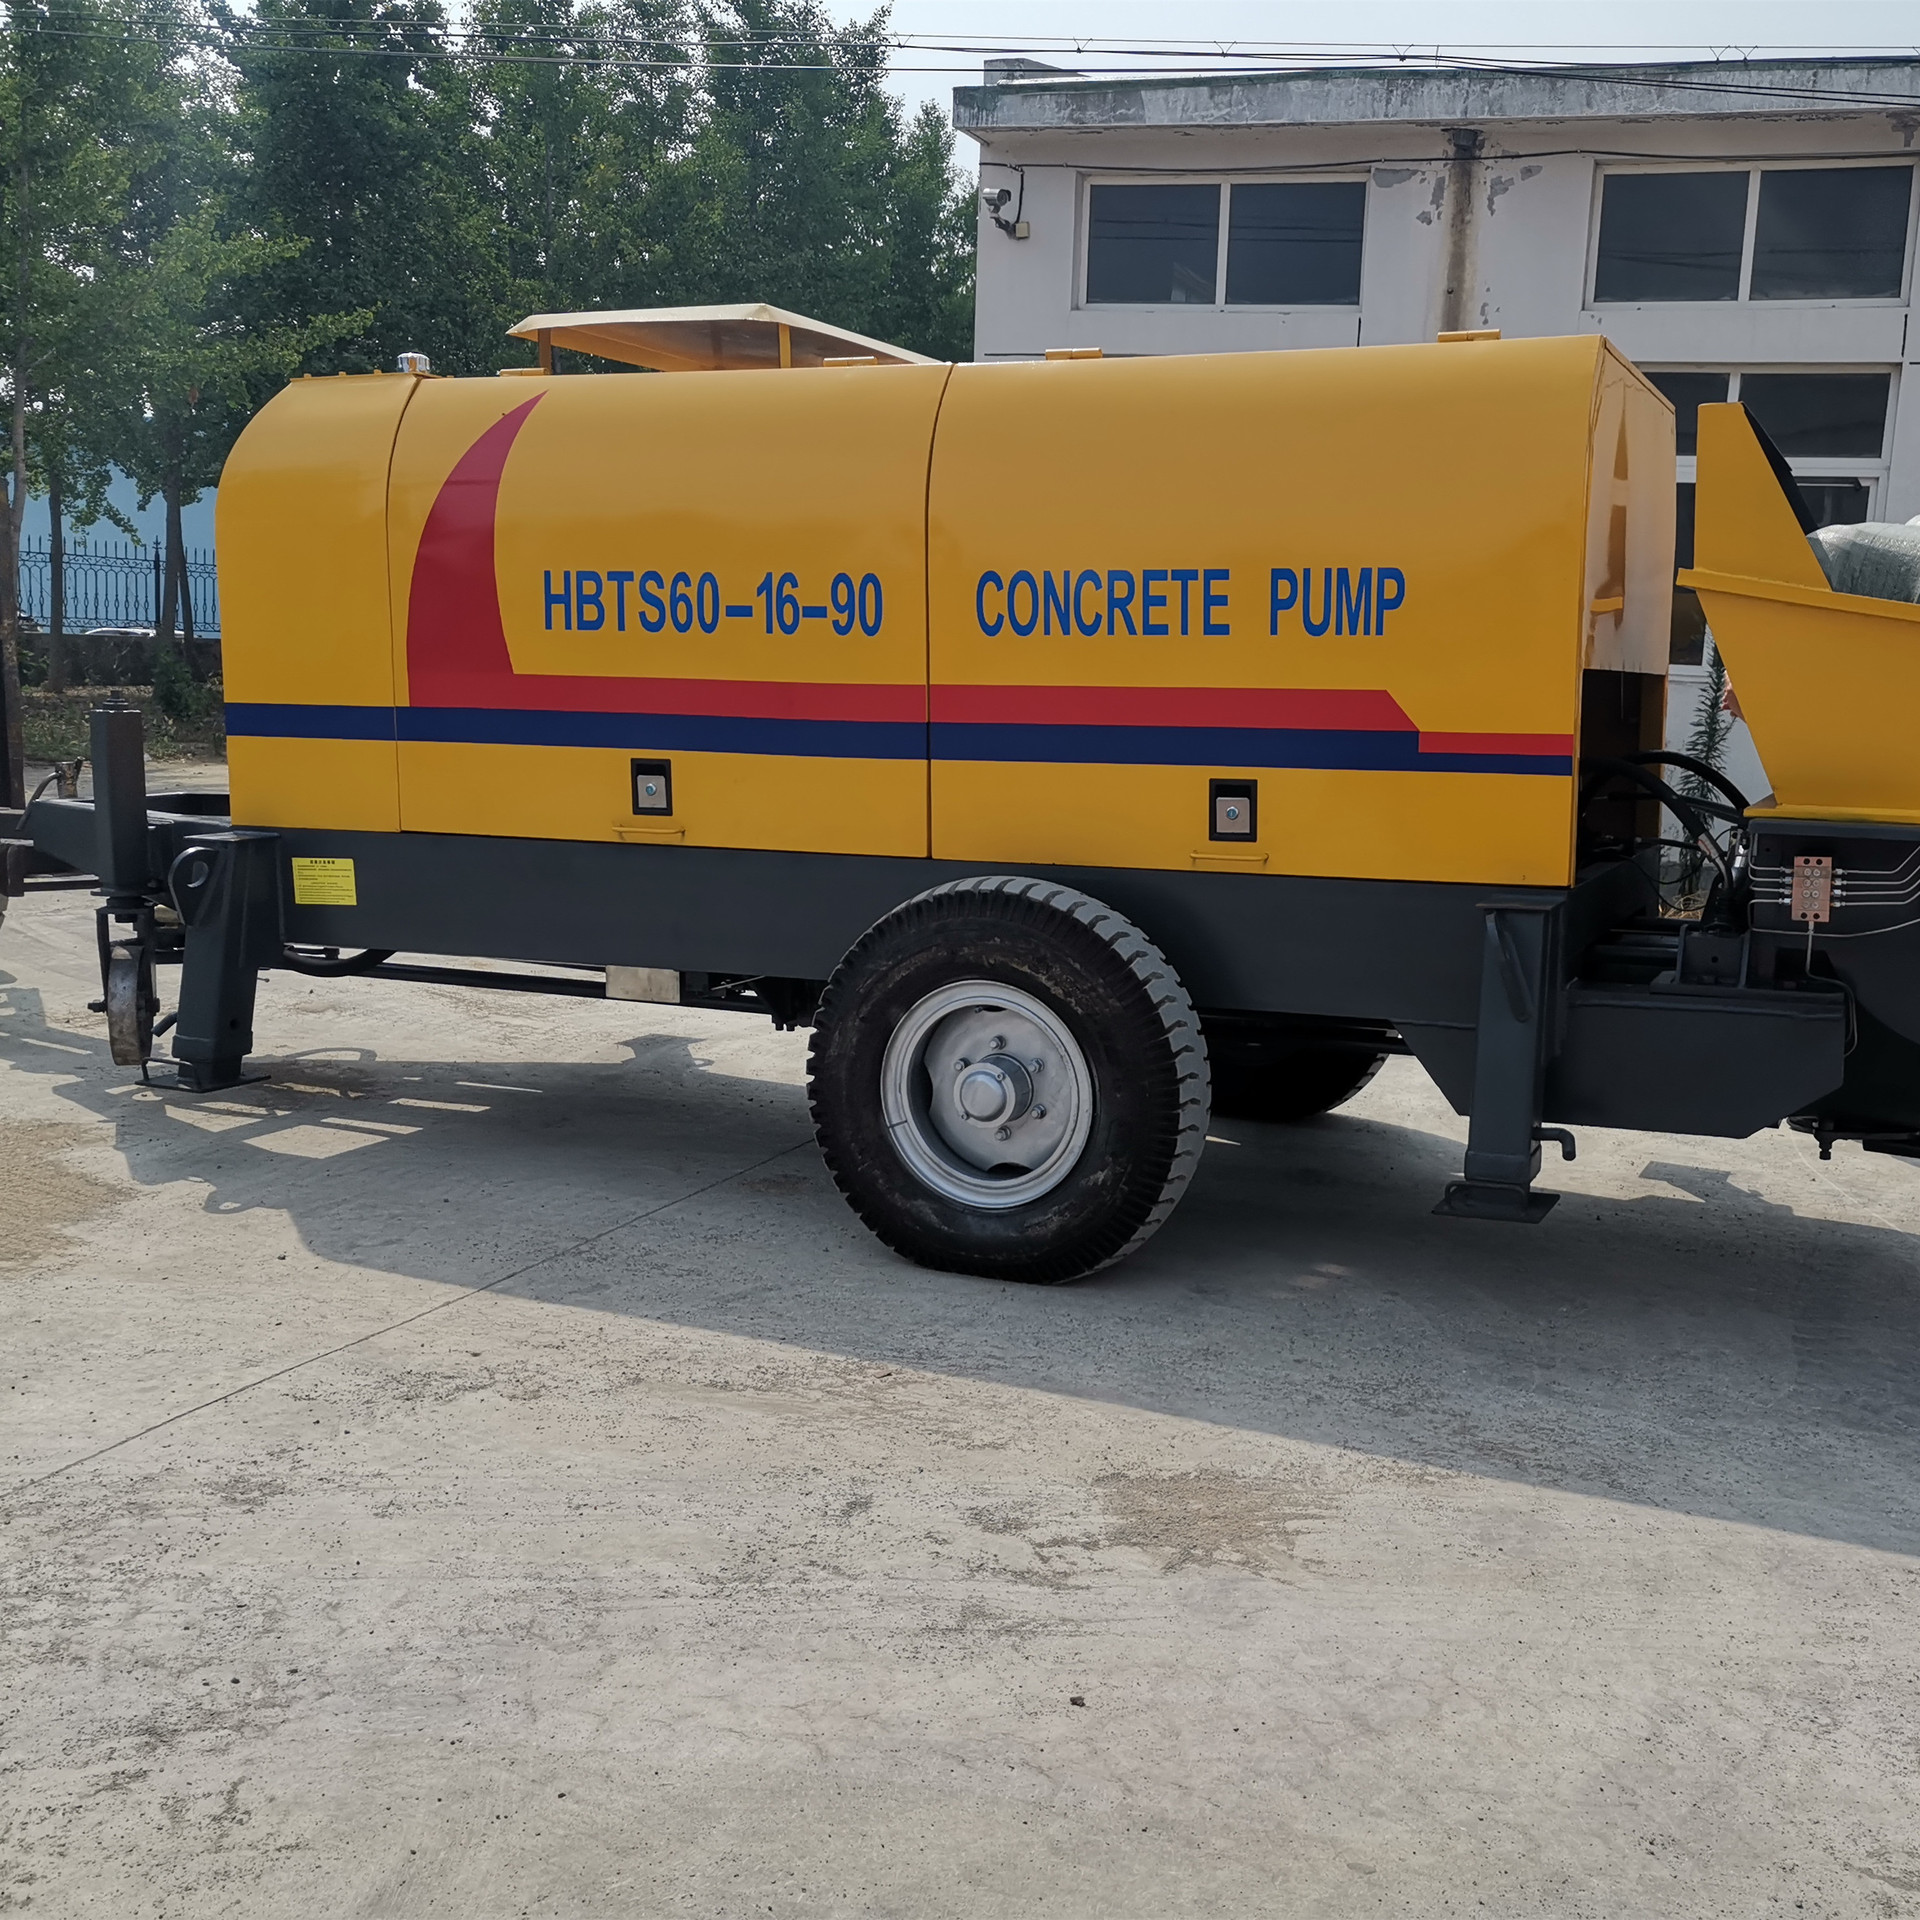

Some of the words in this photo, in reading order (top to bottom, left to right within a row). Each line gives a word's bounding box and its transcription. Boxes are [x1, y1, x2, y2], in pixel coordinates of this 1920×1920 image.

[543, 569, 883, 637] HBTS60-16-90
[976, 568, 1231, 637] CONCRETE
[1269, 566, 1406, 637] PUMP
